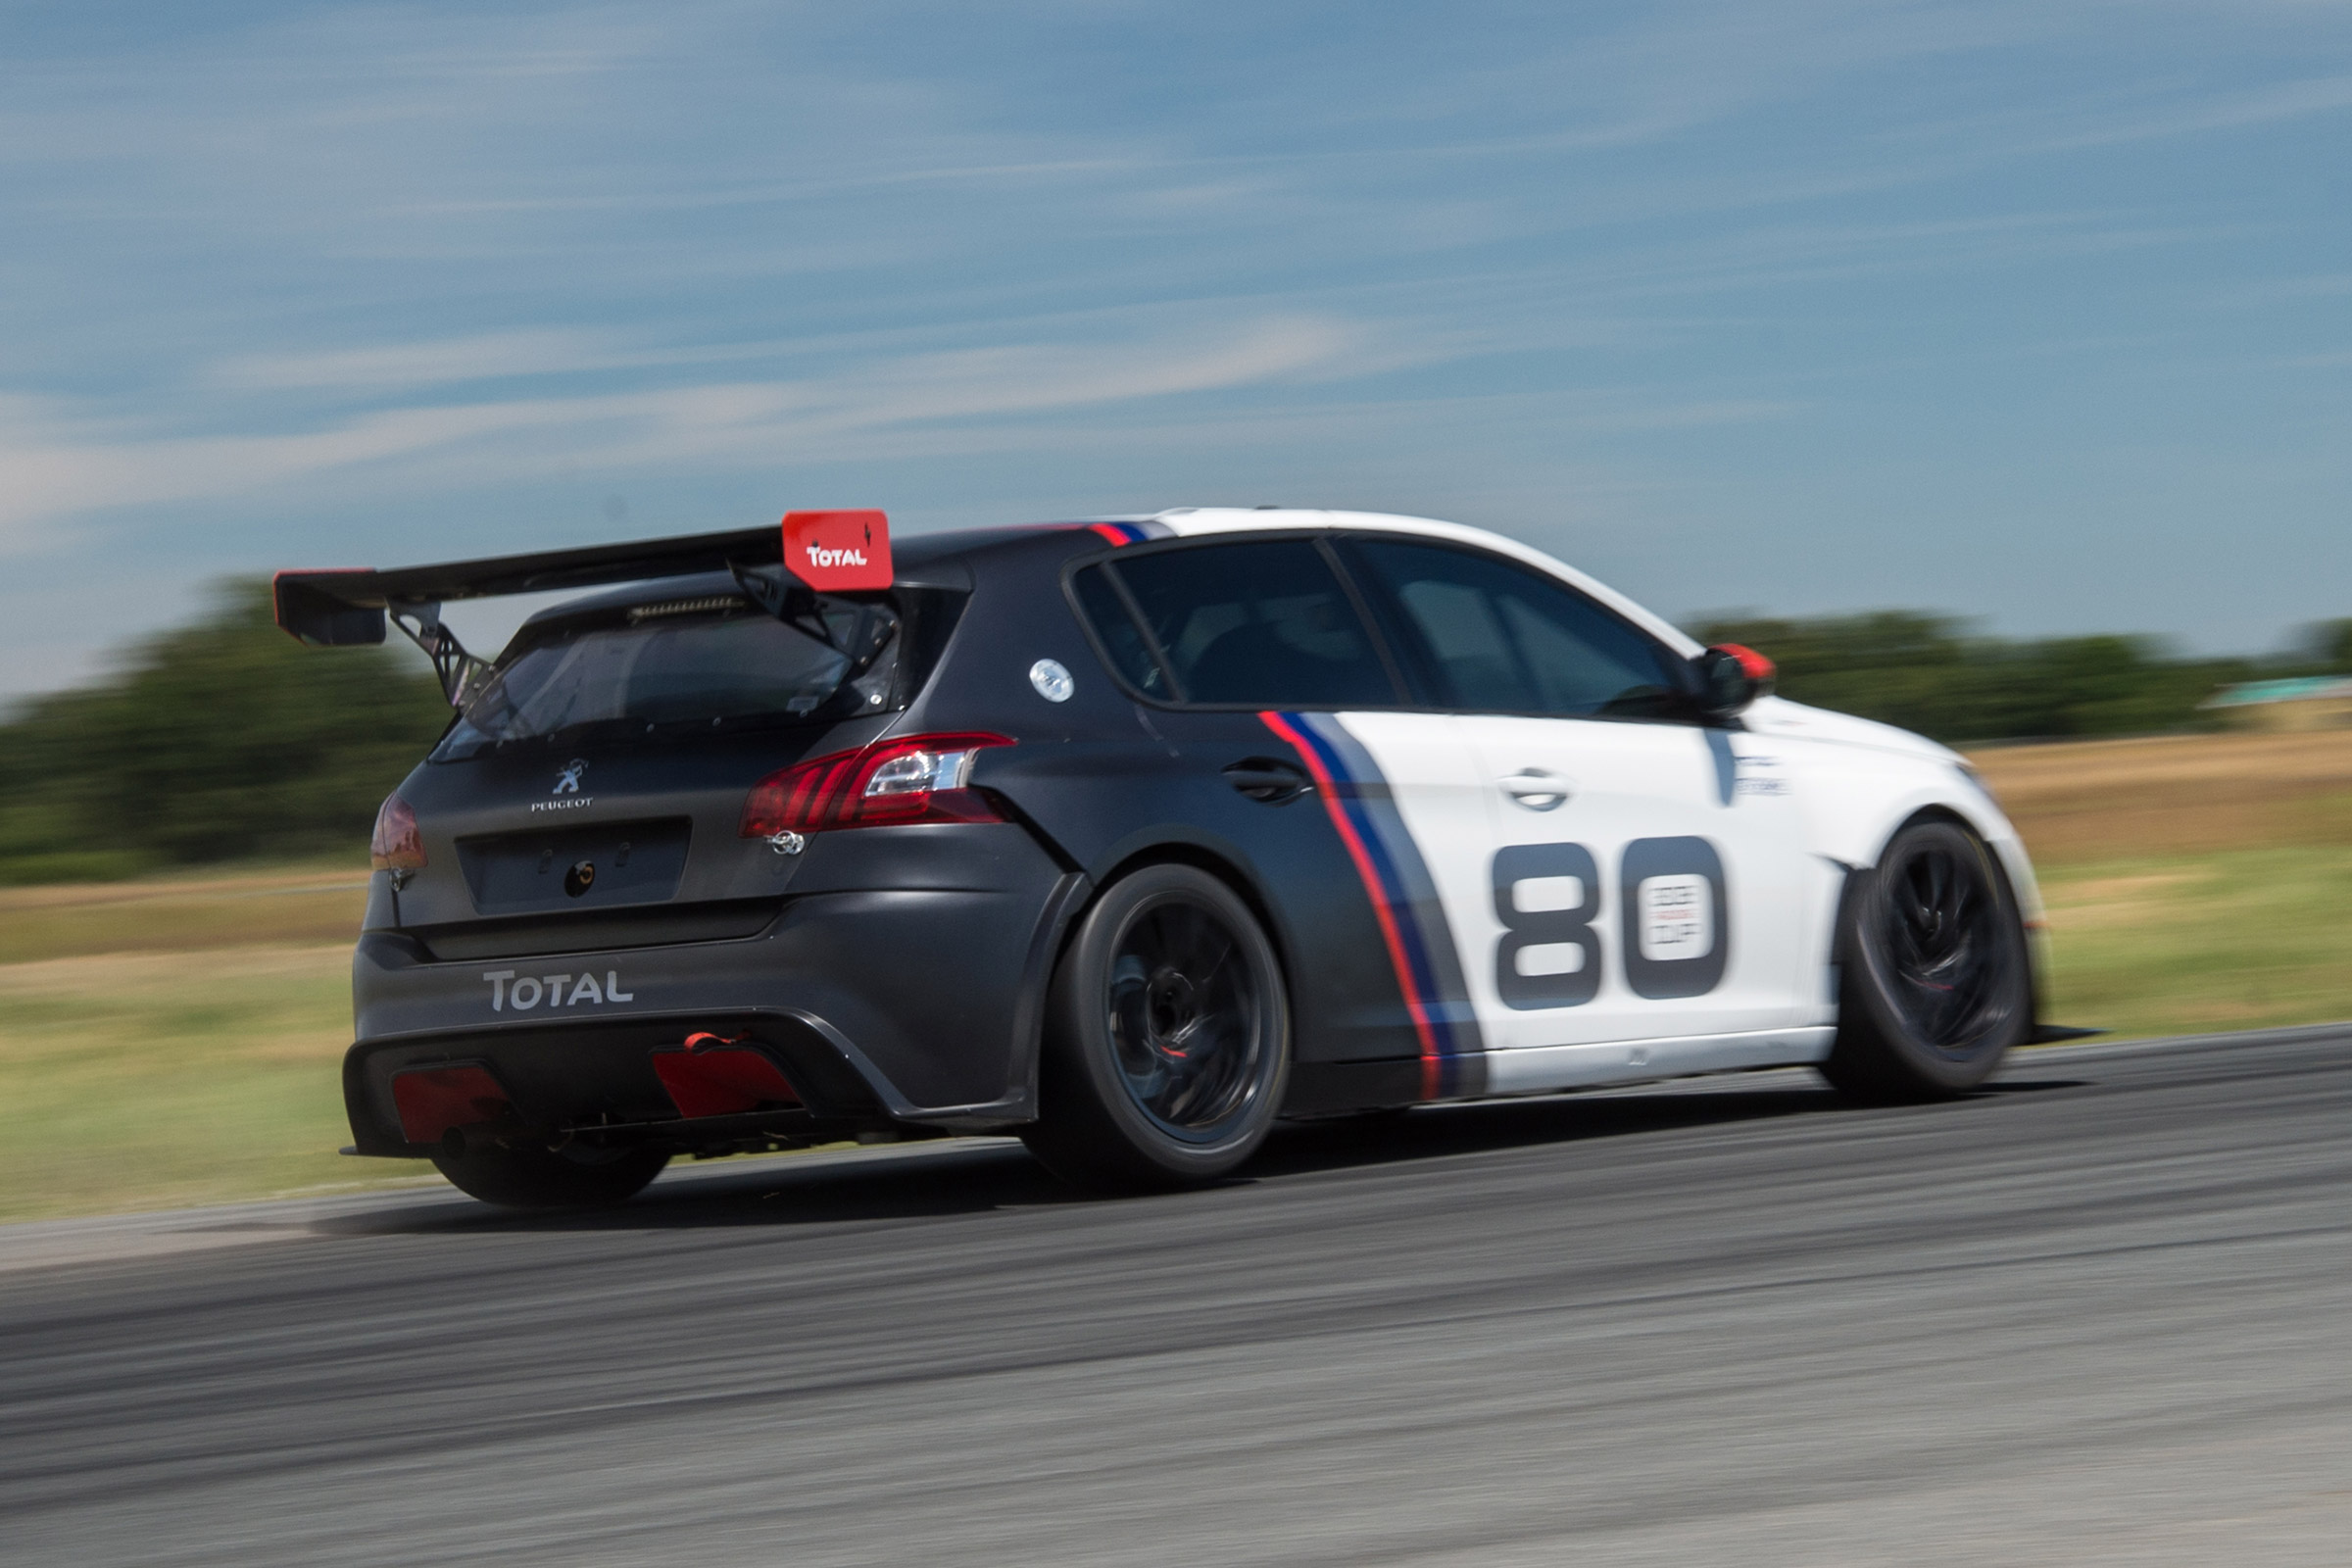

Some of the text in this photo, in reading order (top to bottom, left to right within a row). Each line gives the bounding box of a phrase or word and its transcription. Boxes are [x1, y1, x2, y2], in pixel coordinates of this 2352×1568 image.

[807, 546, 867, 566] TOTAL
[531, 797, 593, 812] PEUGEOT
[1490, 835, 1729, 1011] 80
[483, 969, 634, 1012] TOTAL
